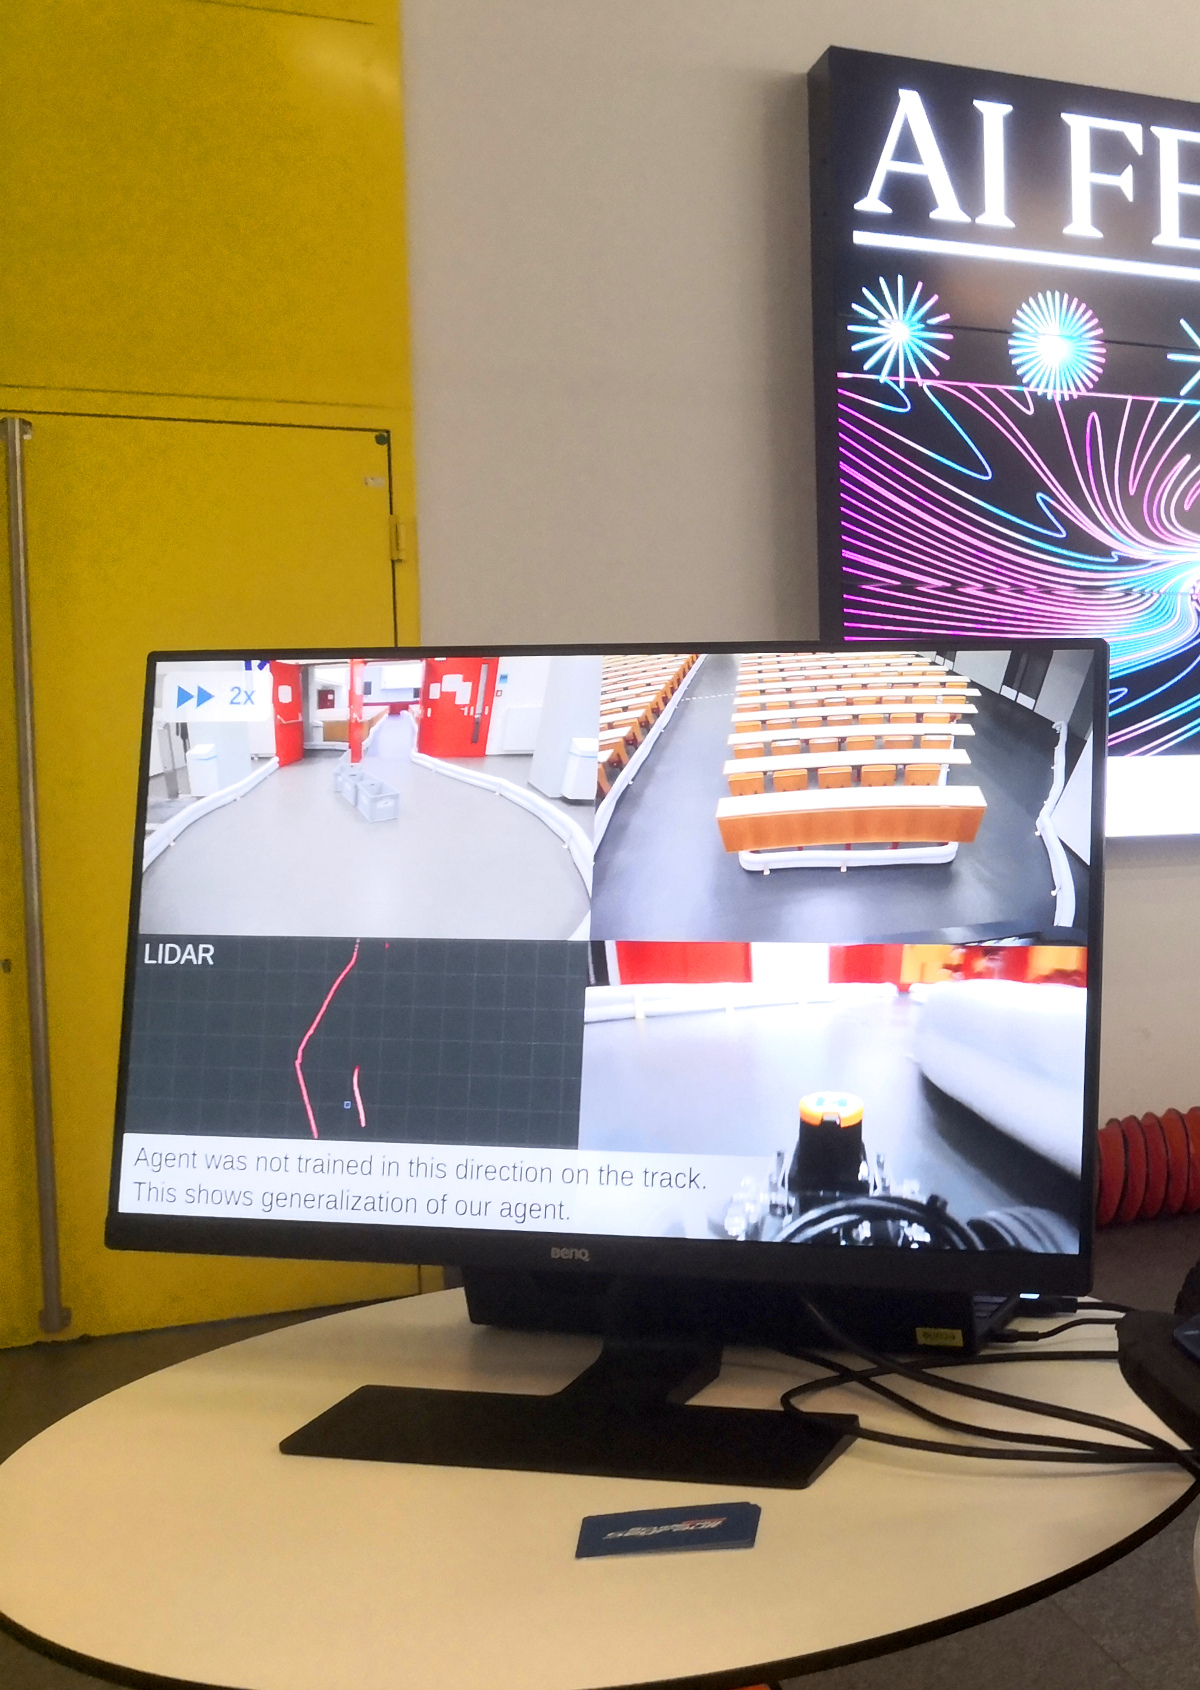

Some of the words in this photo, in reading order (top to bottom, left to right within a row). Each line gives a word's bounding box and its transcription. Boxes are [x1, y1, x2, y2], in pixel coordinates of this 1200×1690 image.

[853, 87, 1016, 228] AI
[229, 686, 256, 705] 2x
[144, 943, 215, 965] LIDAR
[133, 1147, 198, 1173] Agent
[204, 1153, 248, 1171] was
[256, 1153, 290, 1174] not
[297, 1153, 373, 1176] trained
[381, 1155, 401, 1178] in
[408, 1156, 447, 1180] this
[455, 1158, 553, 1183] direction
[561, 1167, 589, 1185] on
[598, 1164, 634, 1187] the
[643, 1167, 707, 1190] track.
[133, 1181, 177, 1204] This
[184, 1184, 253, 1207] shows
[261, 1189, 418, 1214] generalization
[426, 1194, 448, 1215] of
[454, 1199, 492, 1218] our
[500, 1200, 570, 1225] agent.
